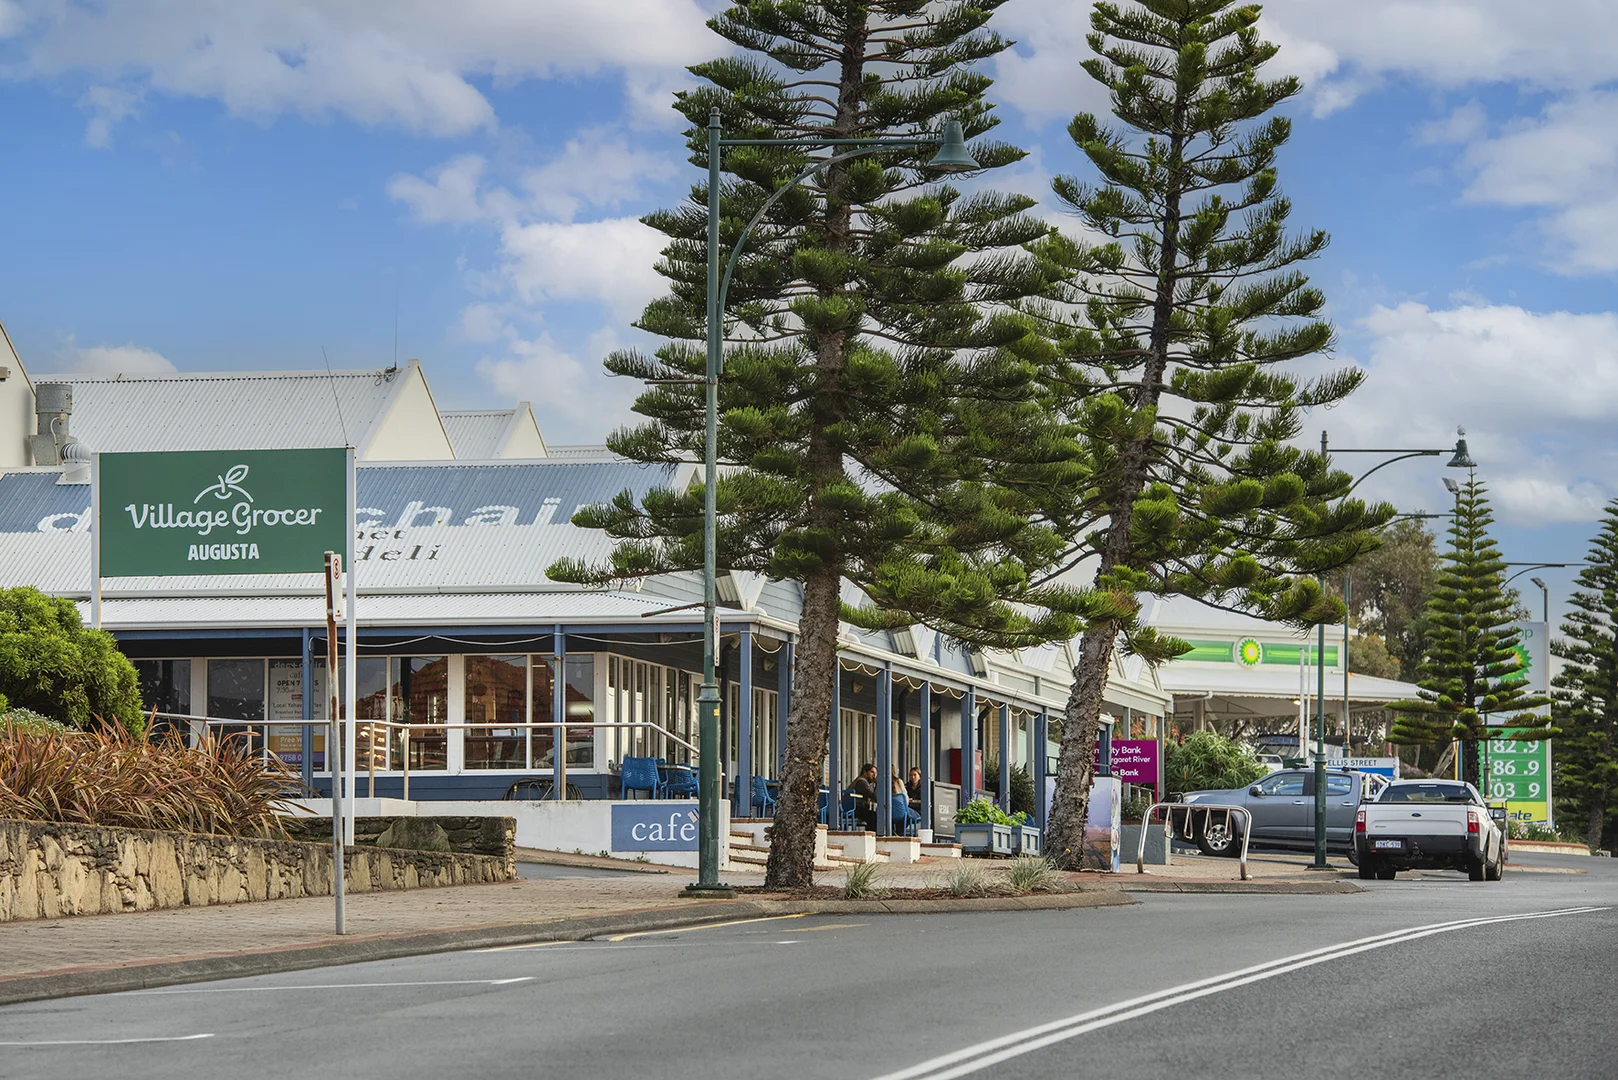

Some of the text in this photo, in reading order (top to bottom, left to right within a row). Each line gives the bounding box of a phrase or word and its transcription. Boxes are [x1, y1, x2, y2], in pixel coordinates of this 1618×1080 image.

[124, 503, 230, 536] Village
[231, 502, 323, 535] Grocer
[187, 543, 260, 561] AUGUSTA
[1121, 746, 1142, 754] Bank
